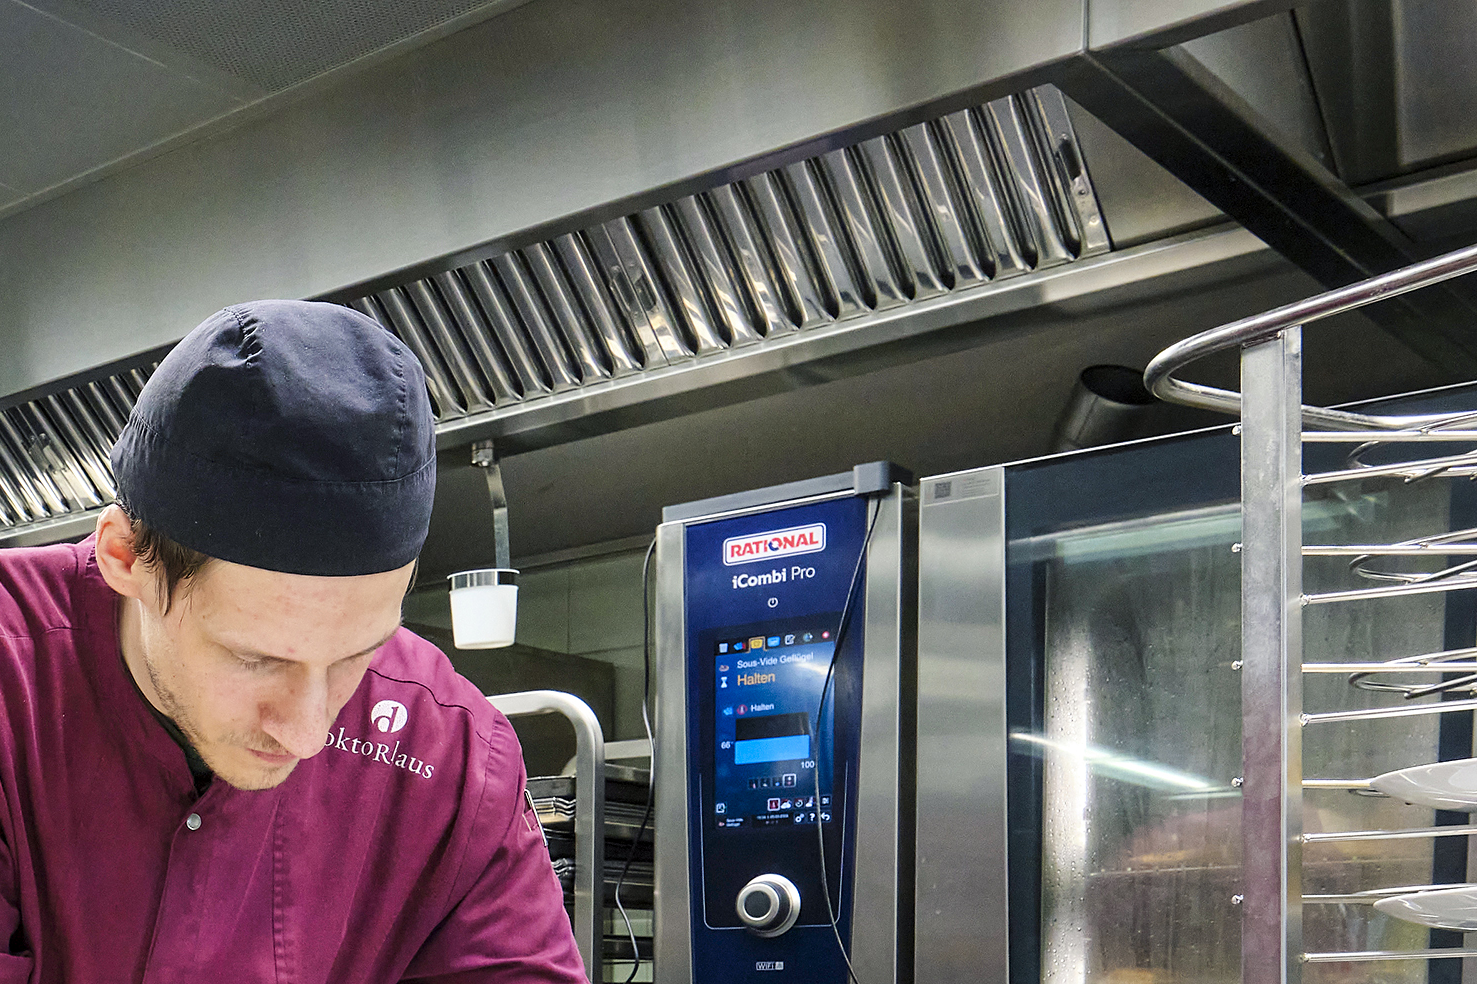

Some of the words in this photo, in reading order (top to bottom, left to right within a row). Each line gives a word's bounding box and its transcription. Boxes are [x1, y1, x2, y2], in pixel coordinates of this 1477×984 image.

[730, 532, 819, 558] RATIONAL
[732, 568, 786, 589] iCombi
[791, 566, 816, 580] Pro
[737, 656, 778, 669] Sous-Vide
[737, 672, 776, 686] Halten
[750, 703, 775, 712] Halten
[801, 760, 815, 769] 100
